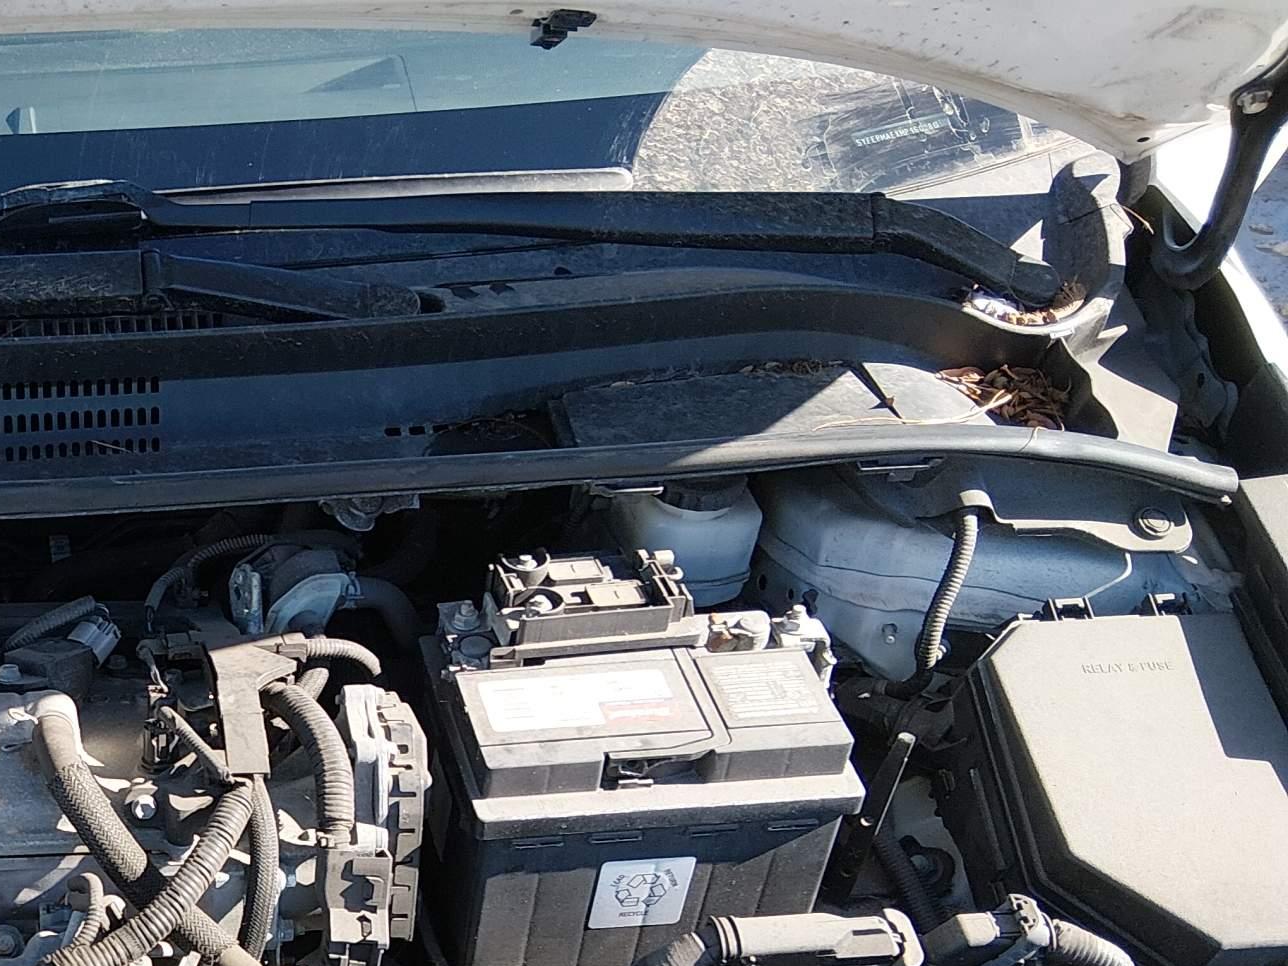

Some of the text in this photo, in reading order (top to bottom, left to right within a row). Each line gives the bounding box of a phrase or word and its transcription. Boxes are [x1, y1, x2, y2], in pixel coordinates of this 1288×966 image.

[1081, 662, 1123, 674] RELAY
[1139, 660, 1175, 672] FUSE
[618, 910, 649, 918] RECYCLE
